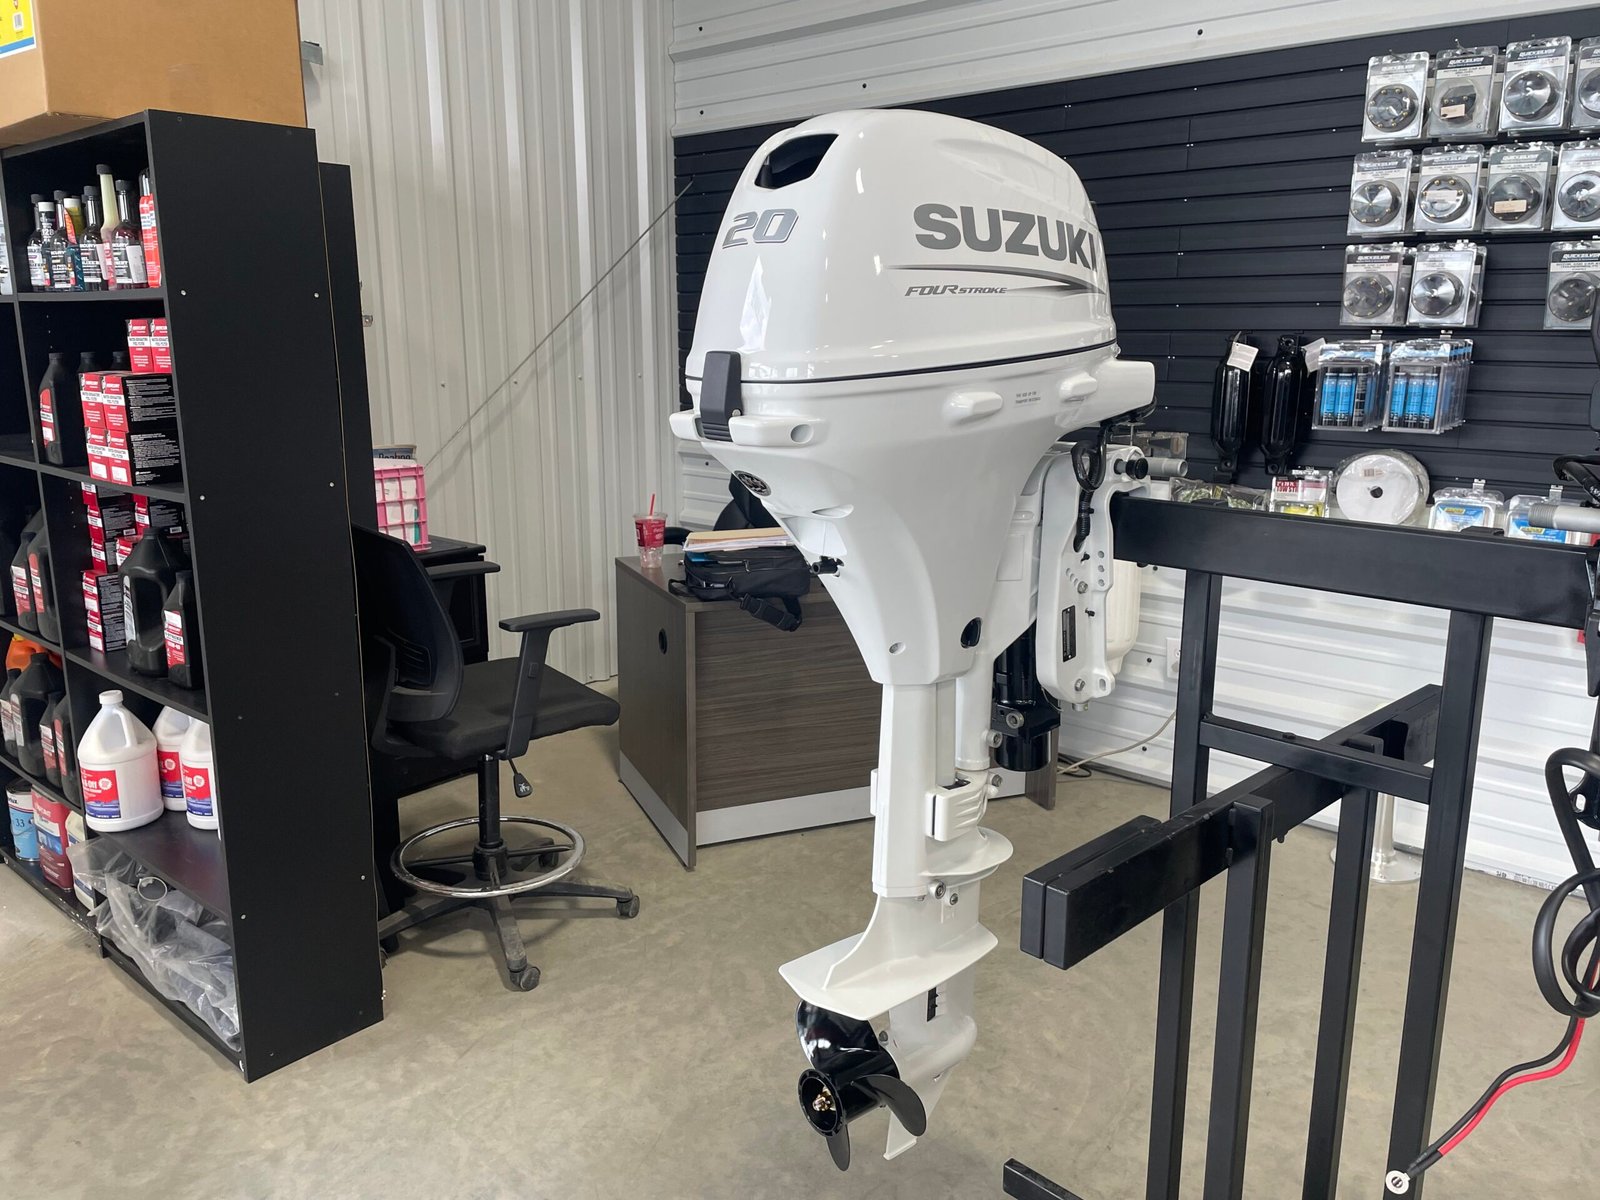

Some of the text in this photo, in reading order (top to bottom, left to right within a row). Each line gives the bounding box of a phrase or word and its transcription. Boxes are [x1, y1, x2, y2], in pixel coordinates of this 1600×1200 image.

[722, 208, 800, 250] 20
[913, 203, 1097, 273] SUZUKI
[904, 284, 1008, 297] FOUR STROKE
[15, 817, 26, 828] 33
